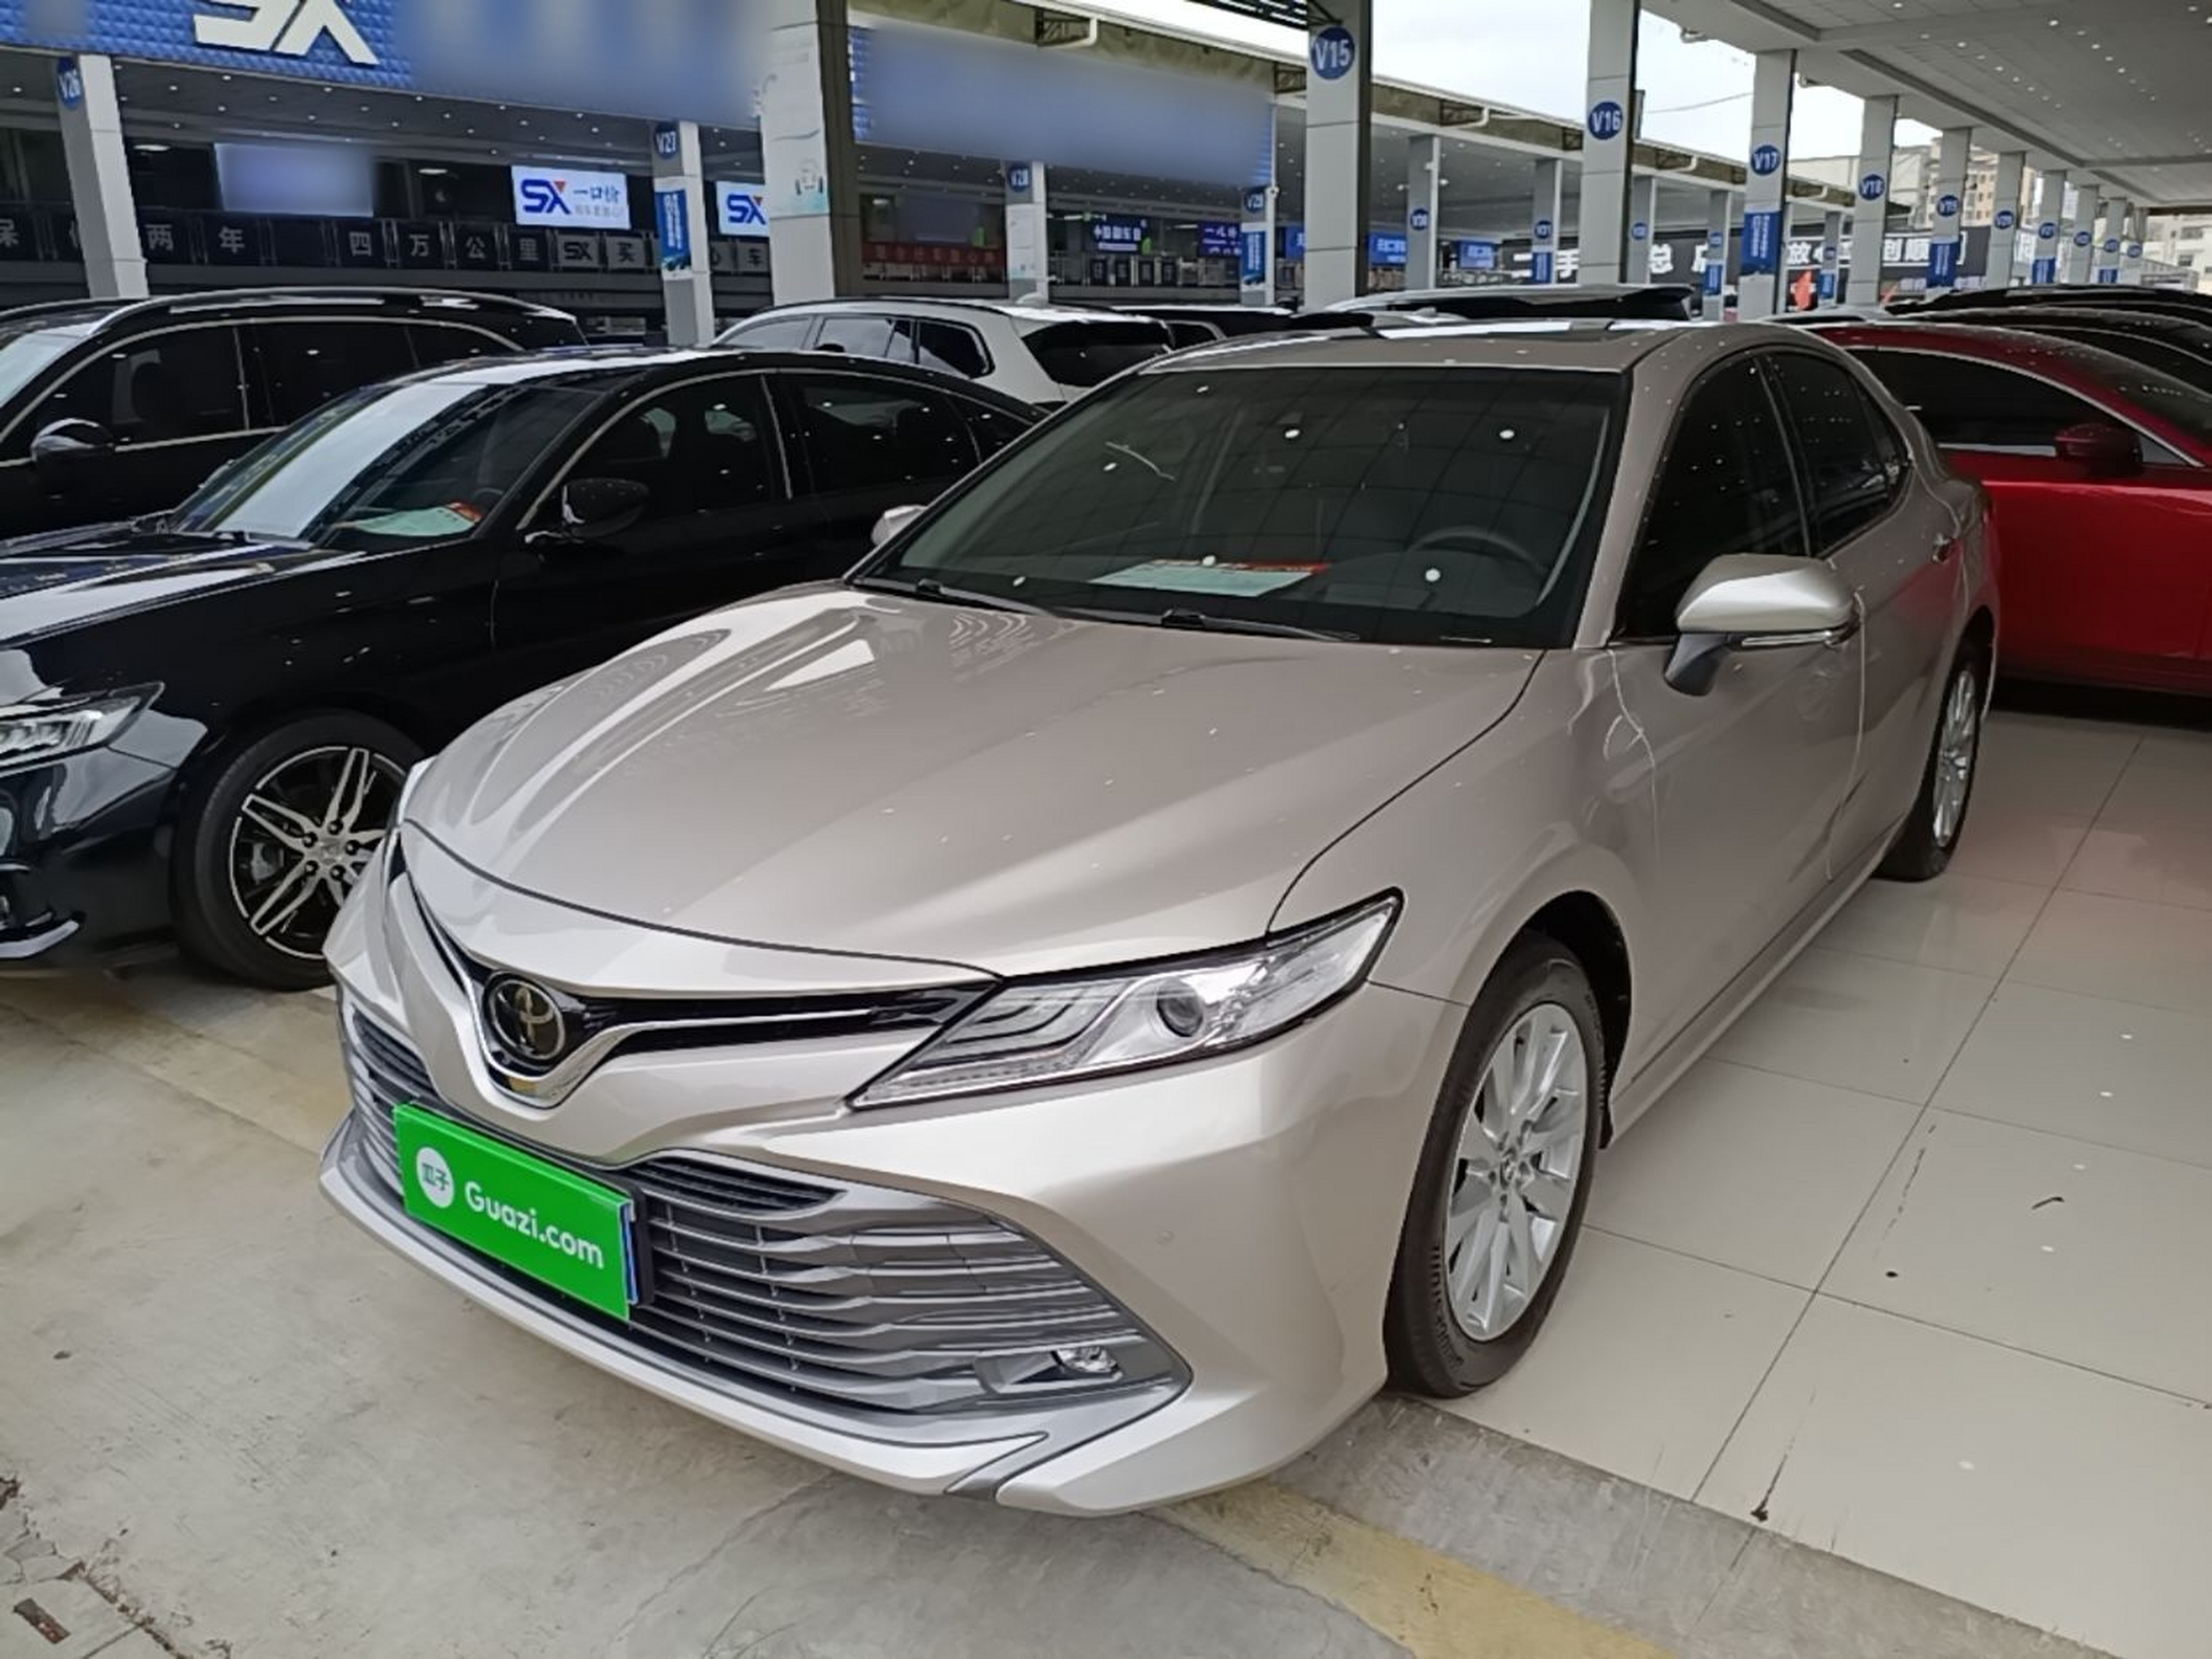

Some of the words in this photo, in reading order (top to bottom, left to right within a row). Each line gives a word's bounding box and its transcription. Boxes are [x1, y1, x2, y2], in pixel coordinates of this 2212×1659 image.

[1316, 39, 1350, 70] V15
[1592, 109, 1621, 132] V16
[657, 131, 676, 154] V27
[1755, 154, 1778, 170] V17
[521, 179, 571, 215] SX
[1862, 180, 1883, 194] V18
[727, 194, 766, 225] SX
[349, 230, 539, 260] 四万公里
[563, 241, 592, 262] SX
[464, 1181, 605, 1269] Guazi.com
